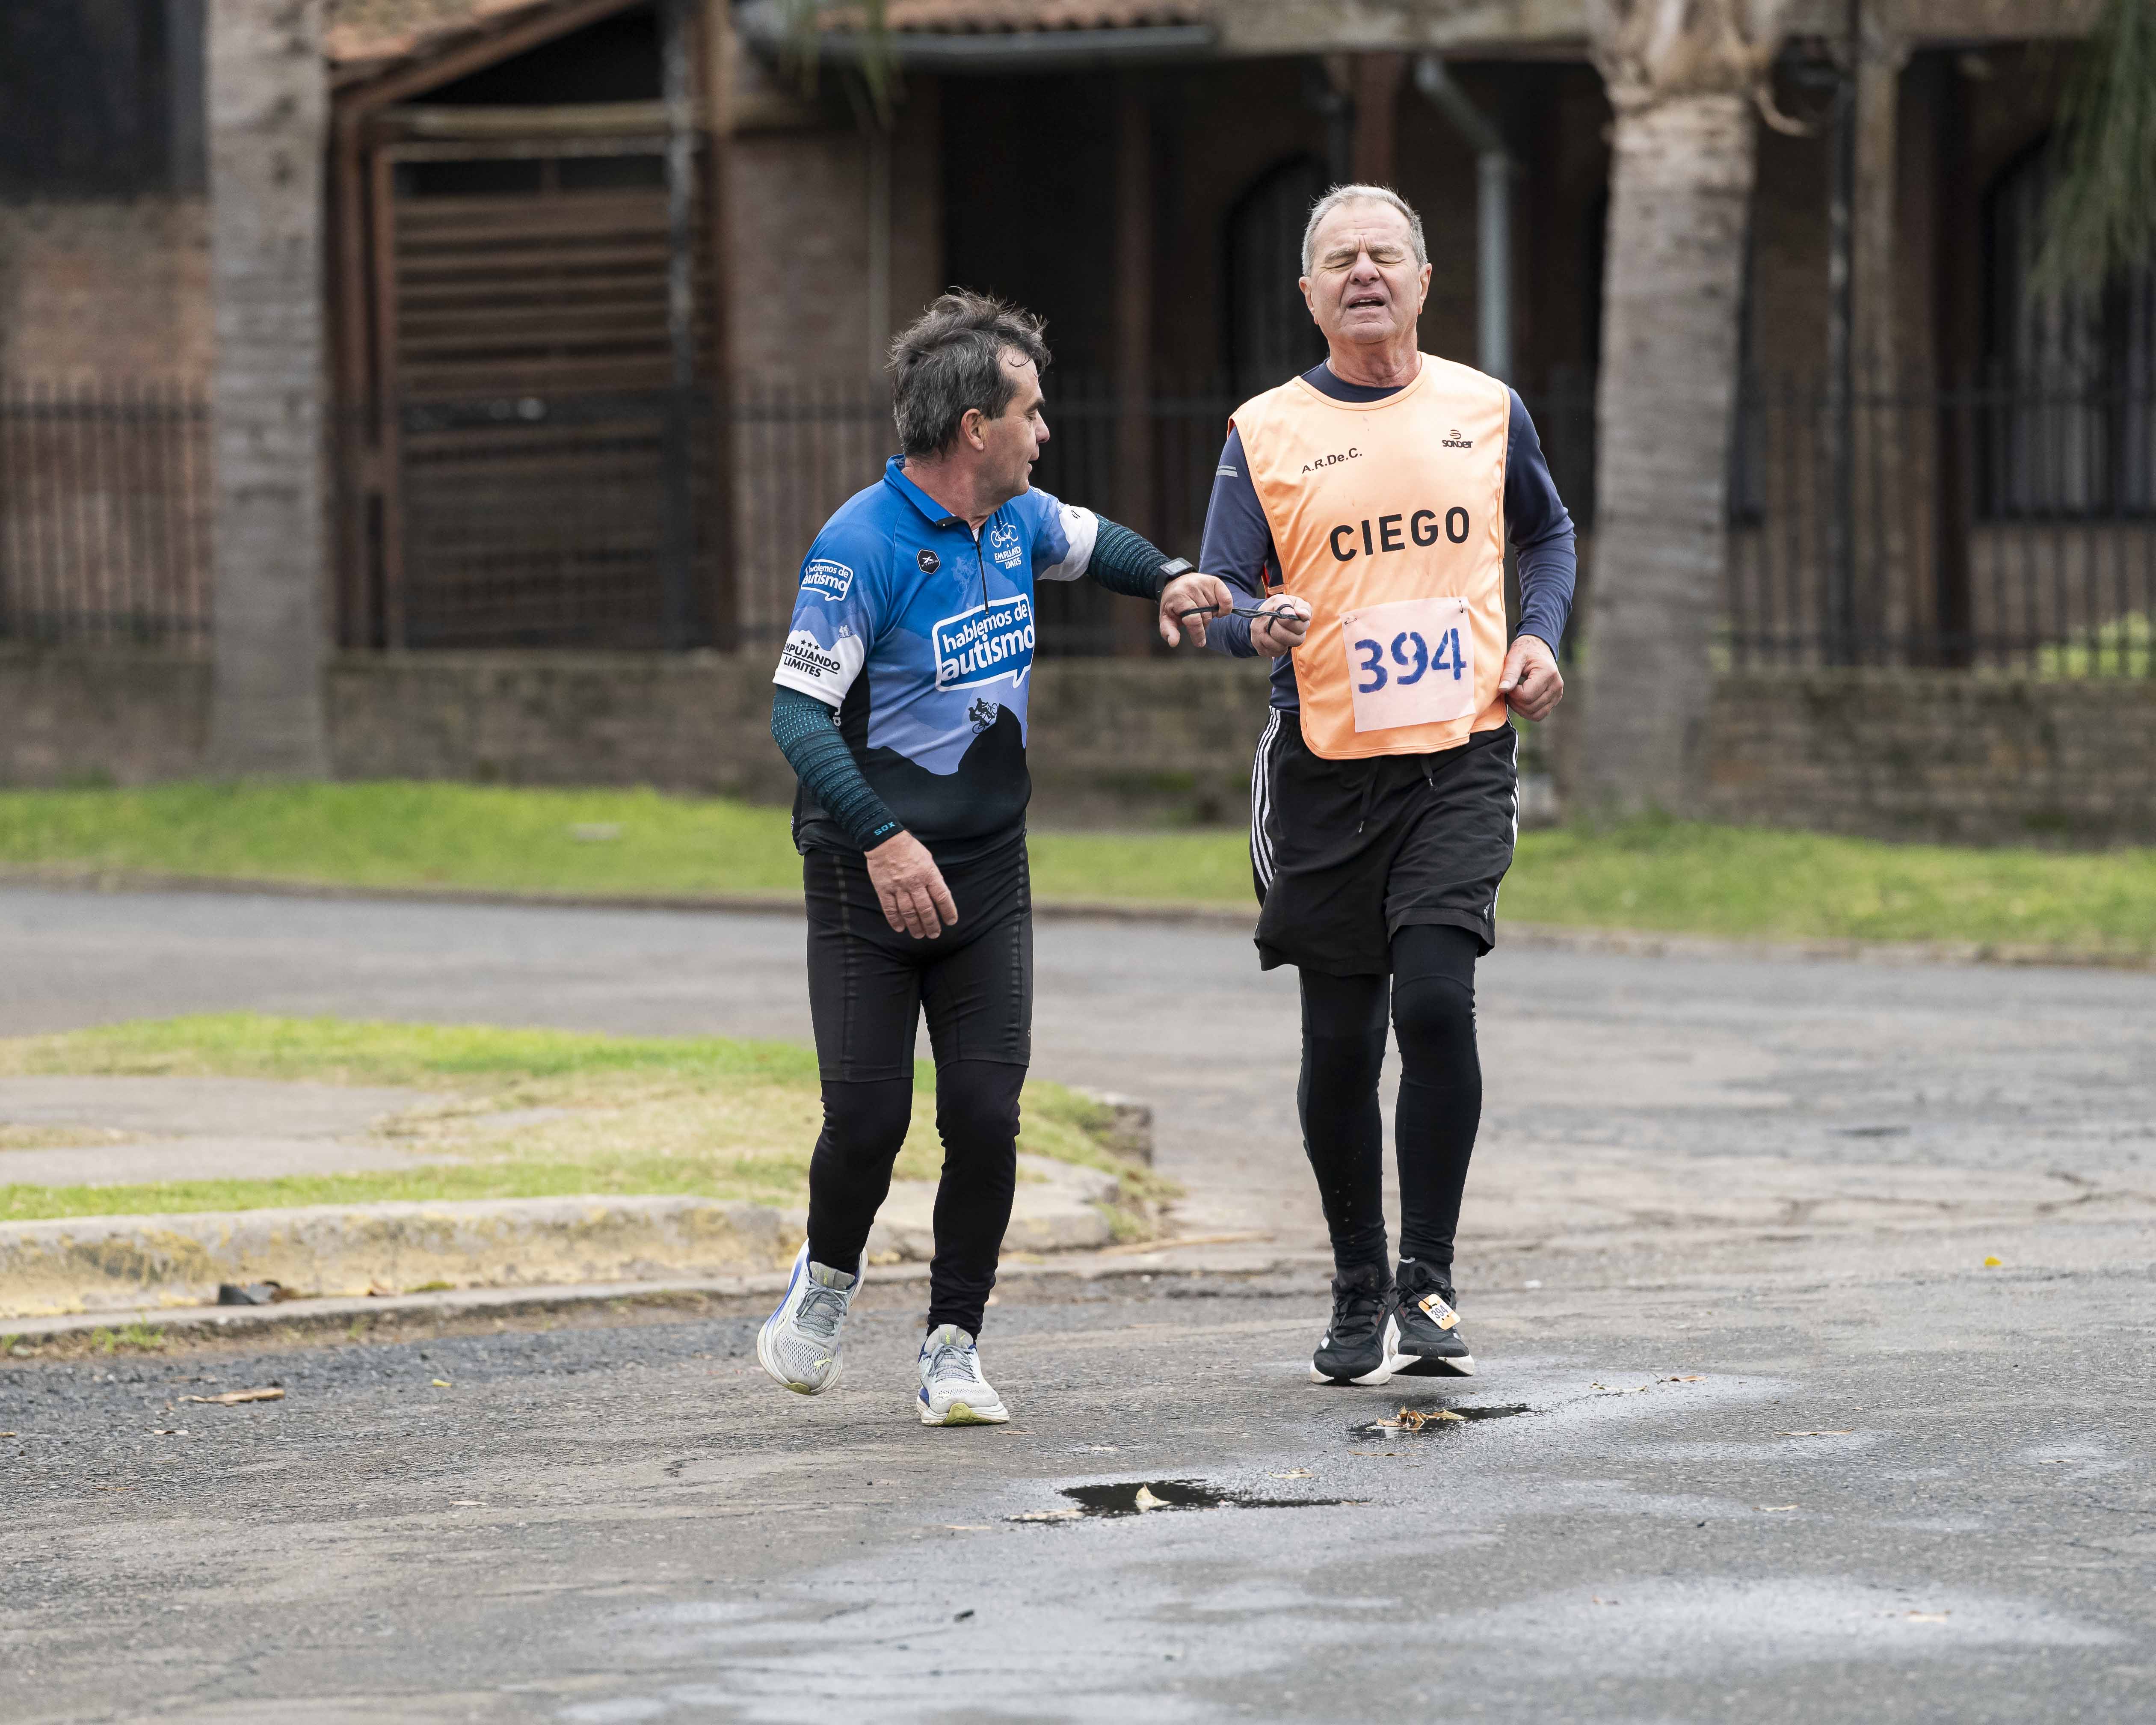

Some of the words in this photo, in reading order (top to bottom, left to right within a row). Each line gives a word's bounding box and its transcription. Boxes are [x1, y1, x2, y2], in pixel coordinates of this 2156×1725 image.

[1302, 448, 1362, 474] A.R.De.C.
[1330, 506, 1469, 562] CIEGO
[803, 571, 848, 592] autismo
[838, 567, 849, 578] de
[942, 610, 1012, 653] hablemos
[1014, 600, 1028, 621] de
[784, 643, 841, 671] MPUJANDO
[941, 625, 1034, 681] autismo
[1354, 628, 1467, 694] 394
[784, 656, 822, 677] LIMITES
[874, 821, 896, 836] SOX
[1431, 1304, 1449, 1319] 394
